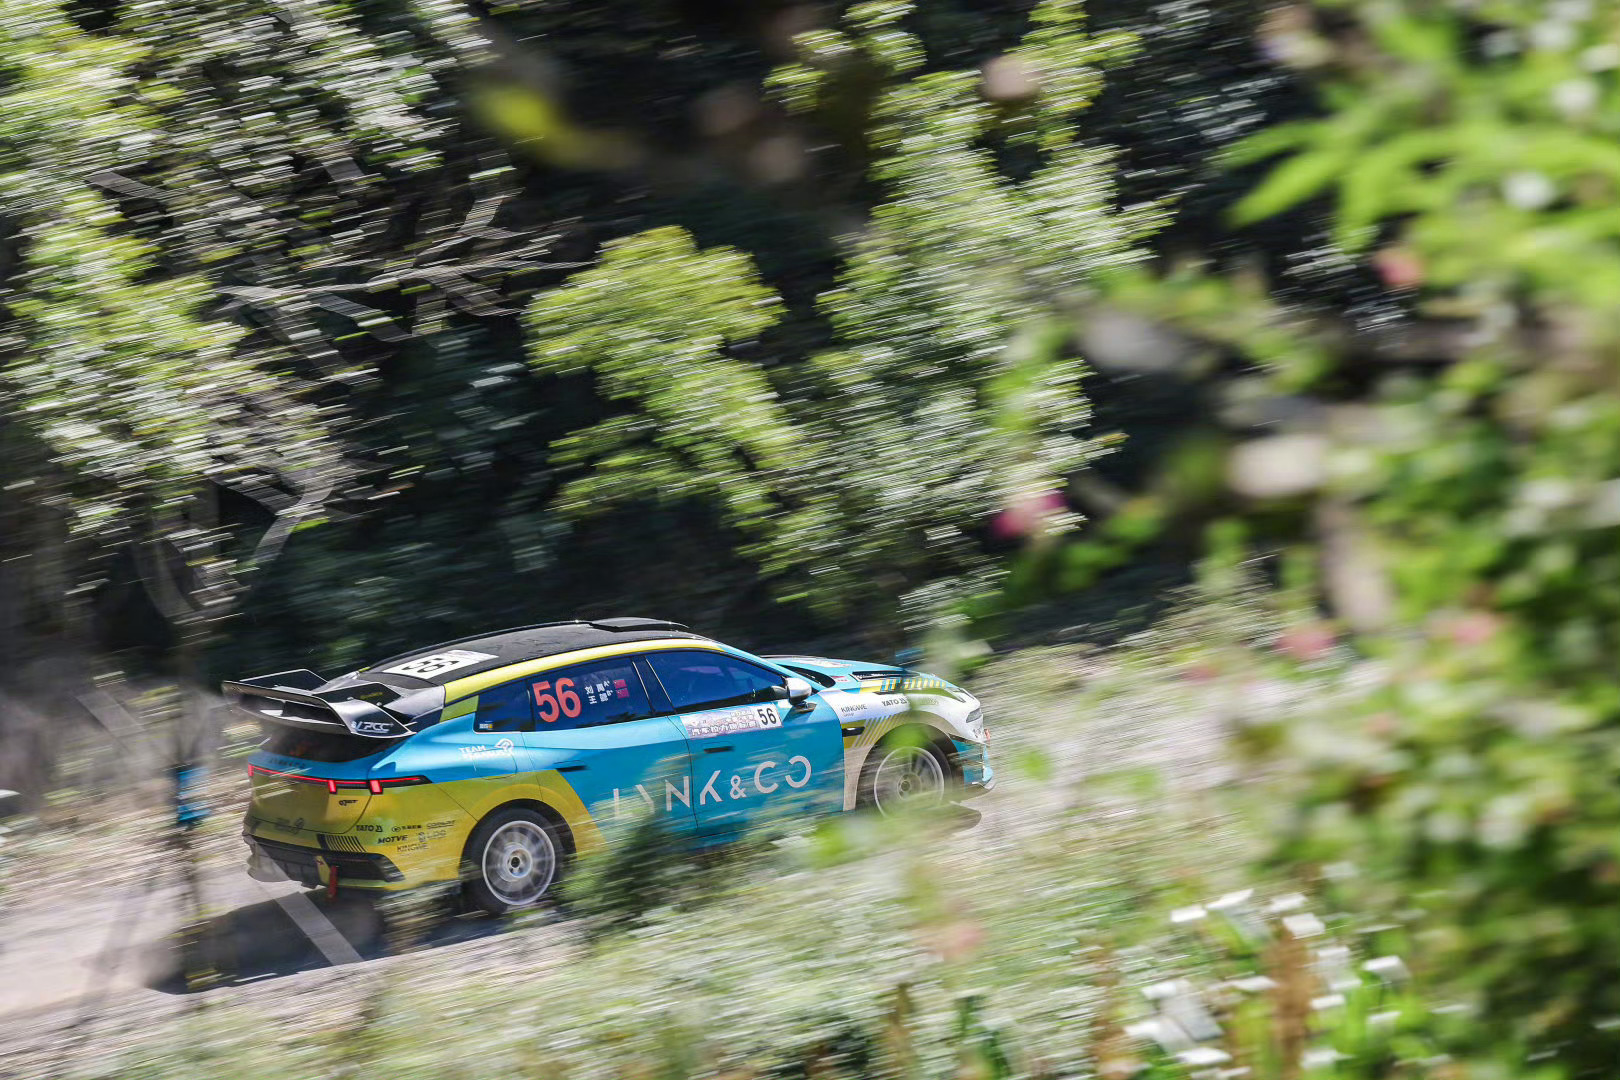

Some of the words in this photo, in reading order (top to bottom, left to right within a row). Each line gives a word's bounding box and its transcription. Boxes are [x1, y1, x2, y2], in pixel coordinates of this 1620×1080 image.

[532, 677, 582, 723] 56
[757, 707, 777, 726] 56
[459, 745, 488, 755] TEAM
